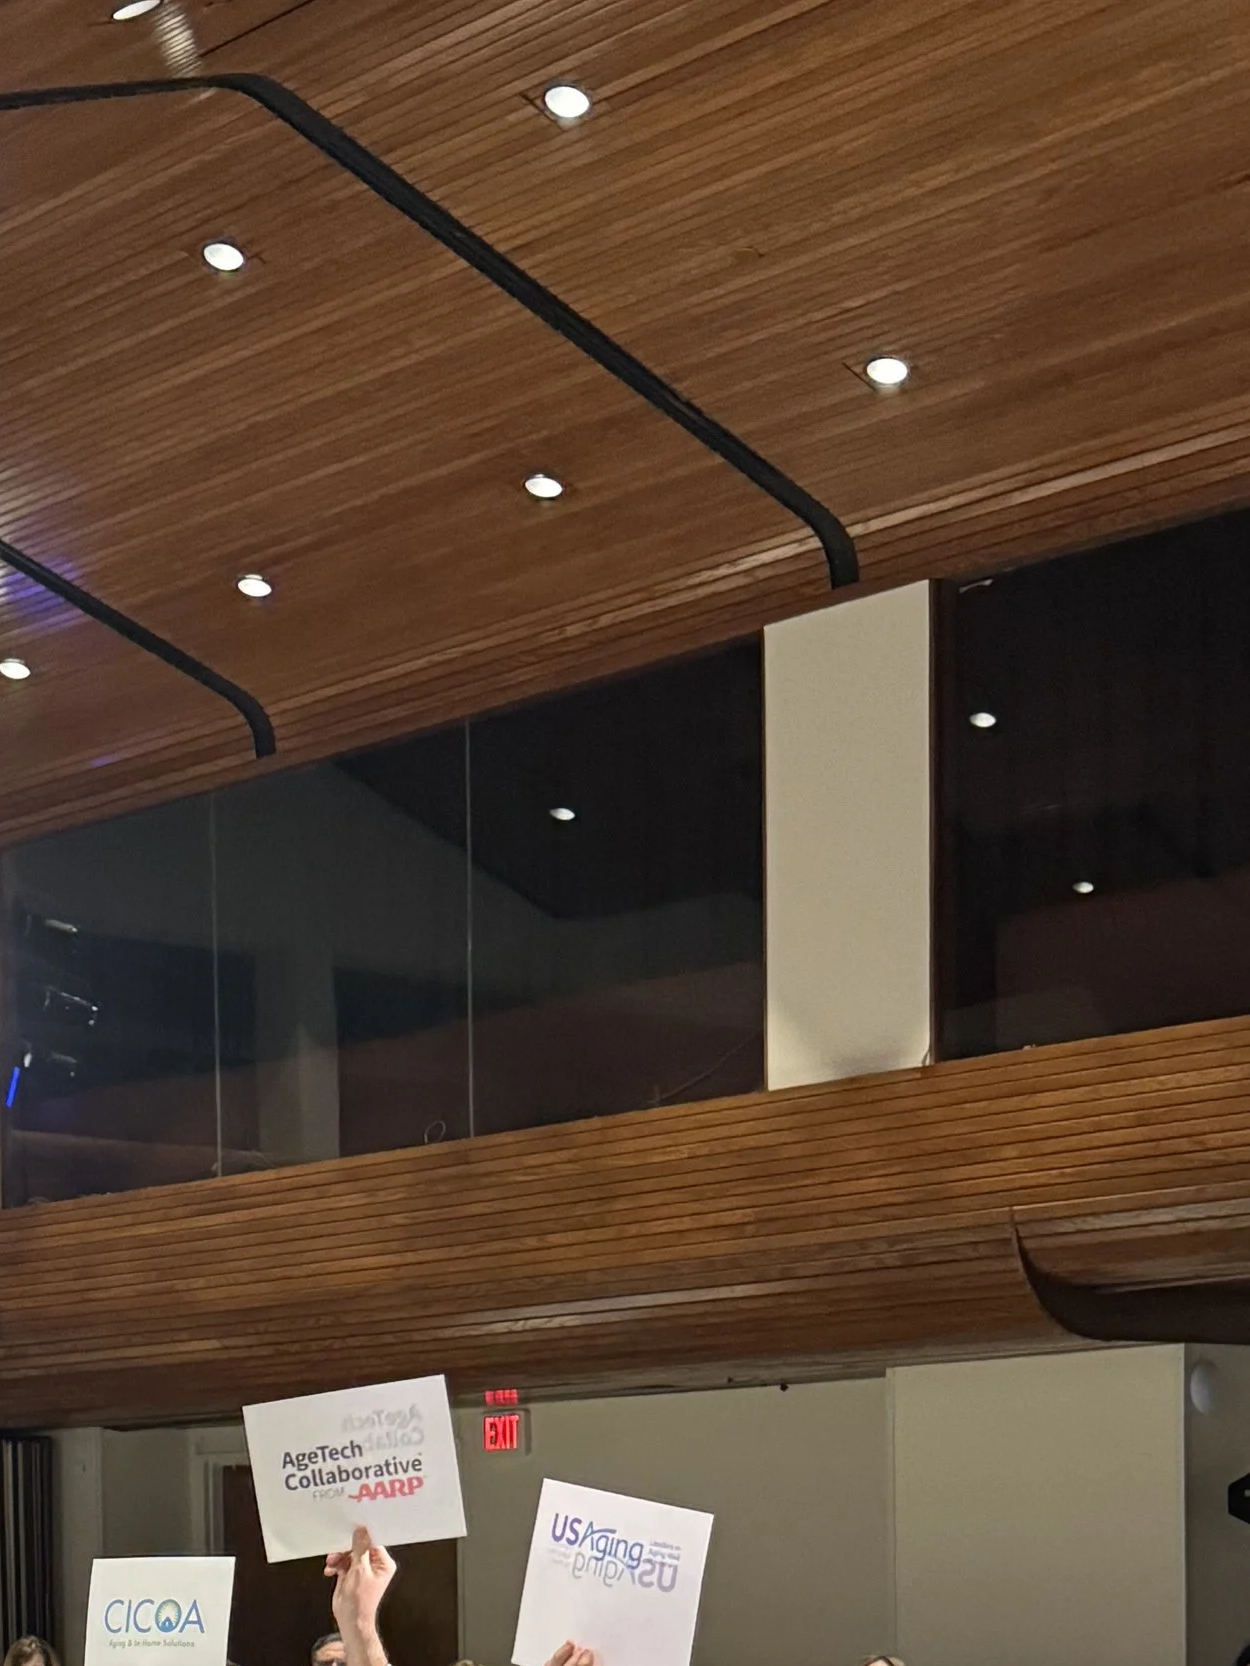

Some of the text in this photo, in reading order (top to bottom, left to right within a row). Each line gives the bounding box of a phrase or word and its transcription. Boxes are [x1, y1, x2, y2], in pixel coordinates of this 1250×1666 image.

[484, 1415, 519, 1450] EXIT
[282, 1440, 363, 1471] AgeTech
[285, 1456, 423, 1491] Collaborative
[312, 1476, 424, 1502] FROM AARP
[551, 1513, 644, 1570] USAging
[104, 1599, 205, 1633] CICOA
